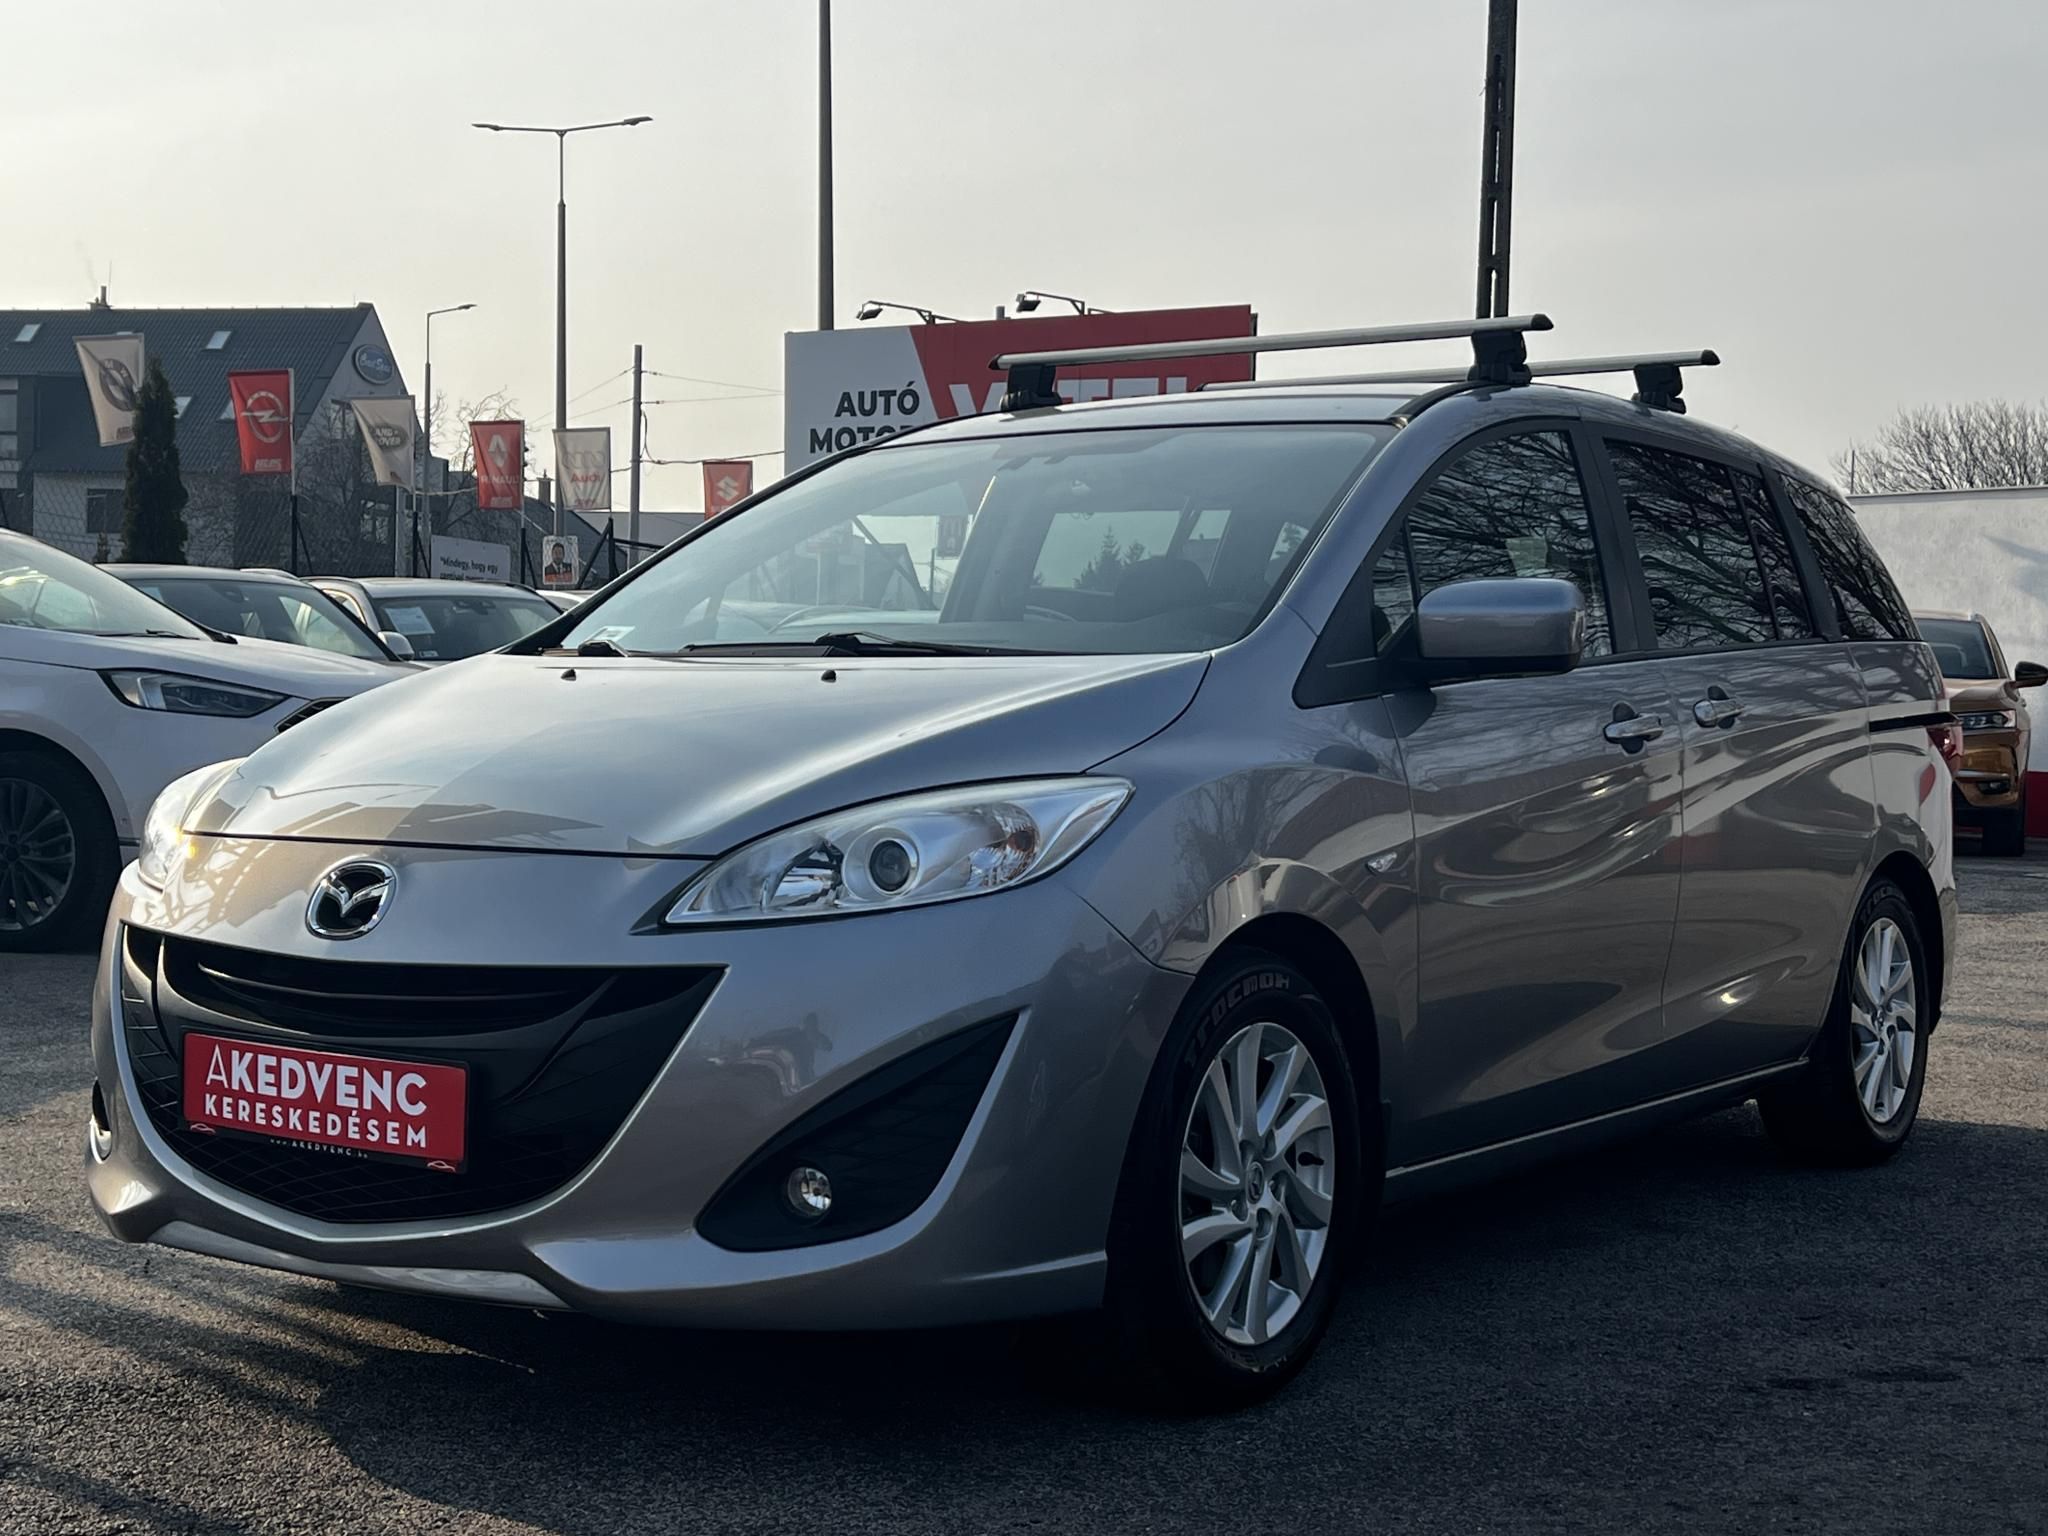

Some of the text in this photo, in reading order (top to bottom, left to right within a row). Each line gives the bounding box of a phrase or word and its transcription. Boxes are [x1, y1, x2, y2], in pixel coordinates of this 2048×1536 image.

[835, 381, 920, 417] AUTÓ
[810, 425, 915, 454] MOT
[570, 472, 601, 484] Audi
[204, 1093, 427, 1148] KERESKEDÉSEM
